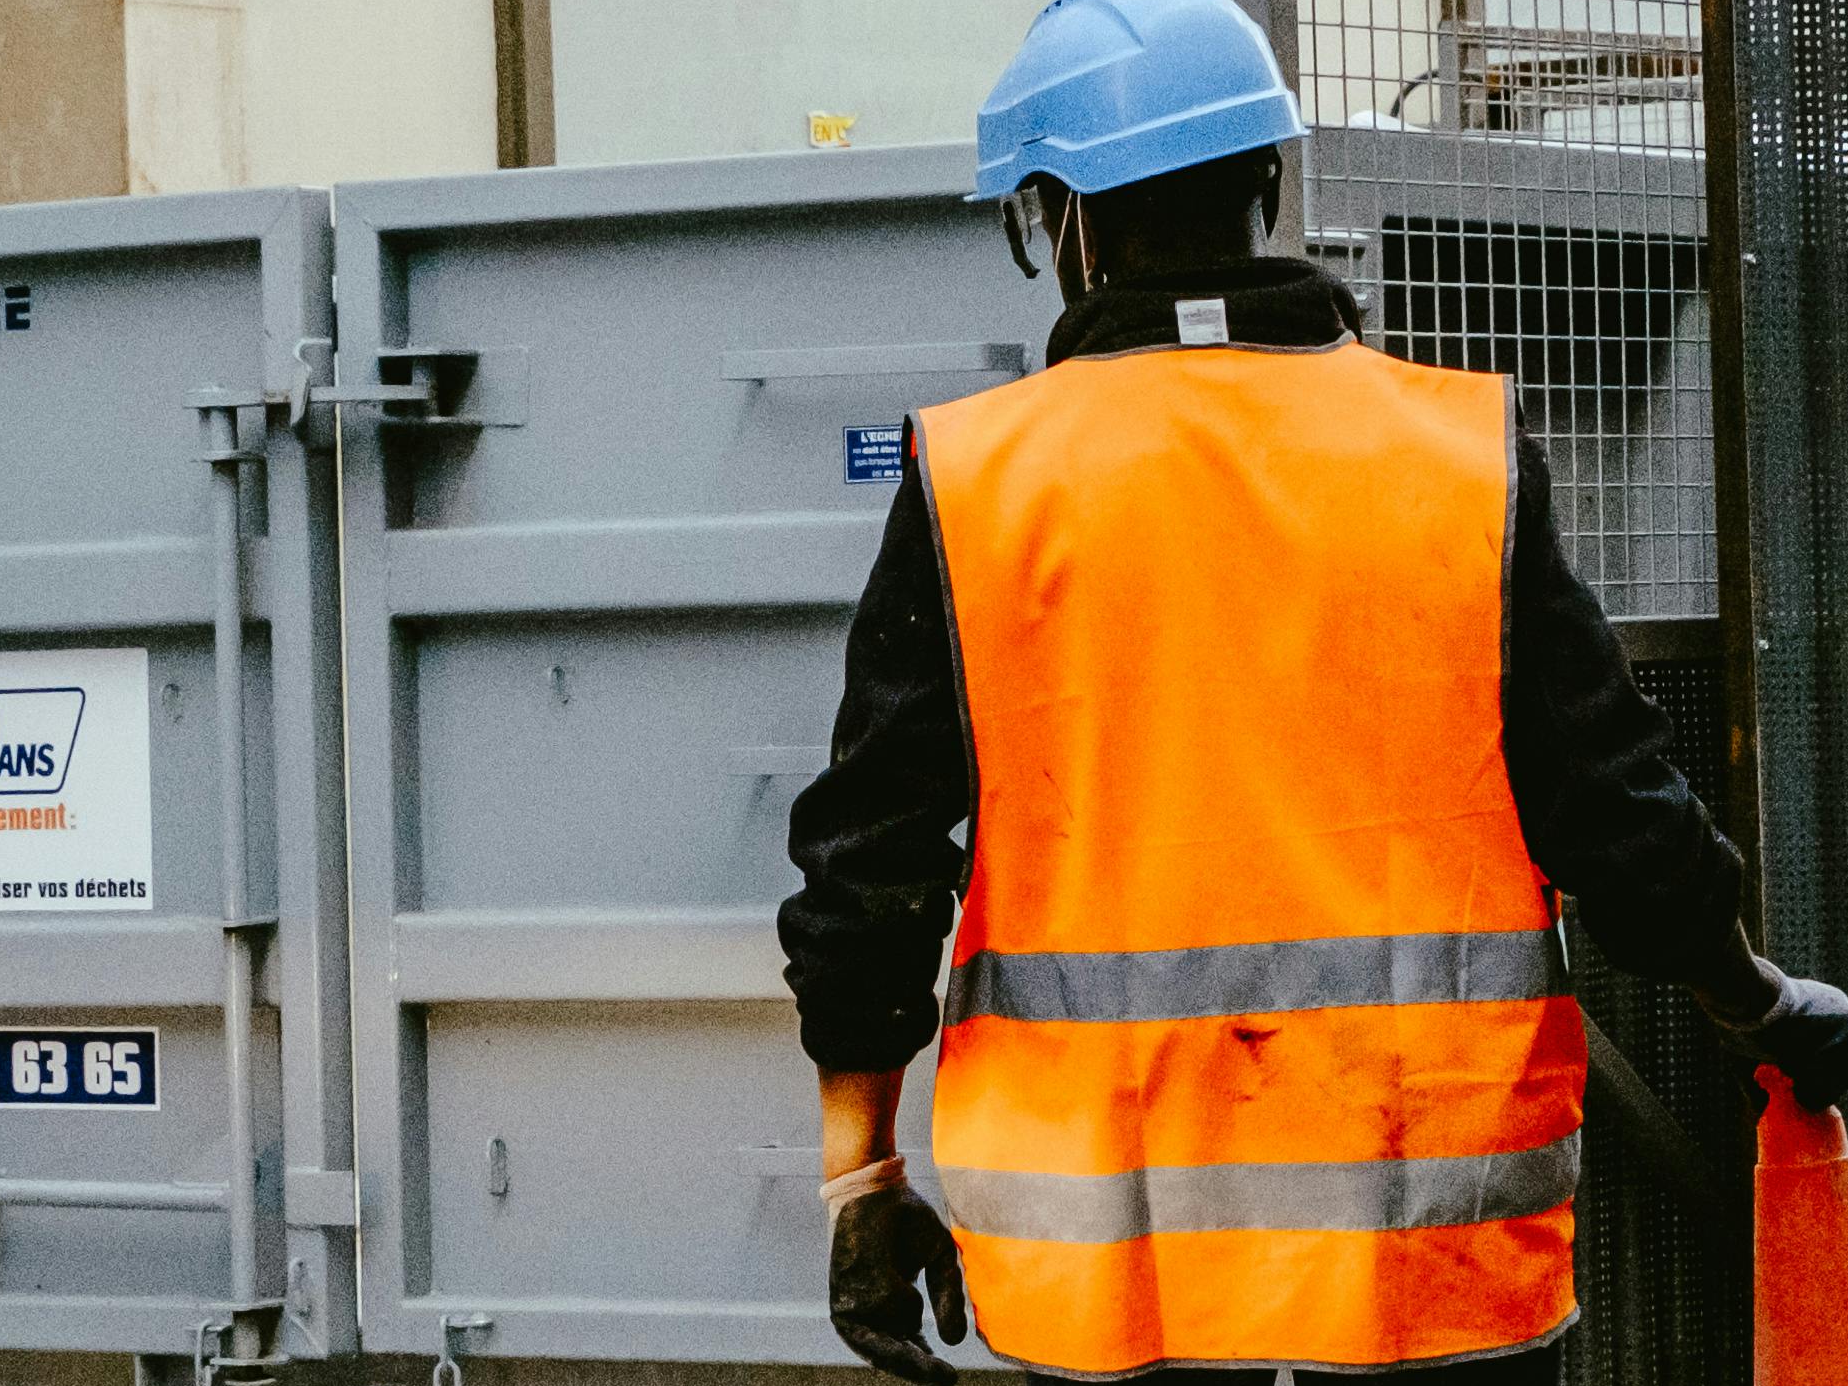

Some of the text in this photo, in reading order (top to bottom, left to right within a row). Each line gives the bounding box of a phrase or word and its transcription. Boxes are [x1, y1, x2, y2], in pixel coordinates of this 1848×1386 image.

[38, 881, 68, 898] vos
[75, 877, 147, 898] déchets
[11, 1040, 68, 1095] 63
[83, 1041, 142, 1095] 65
